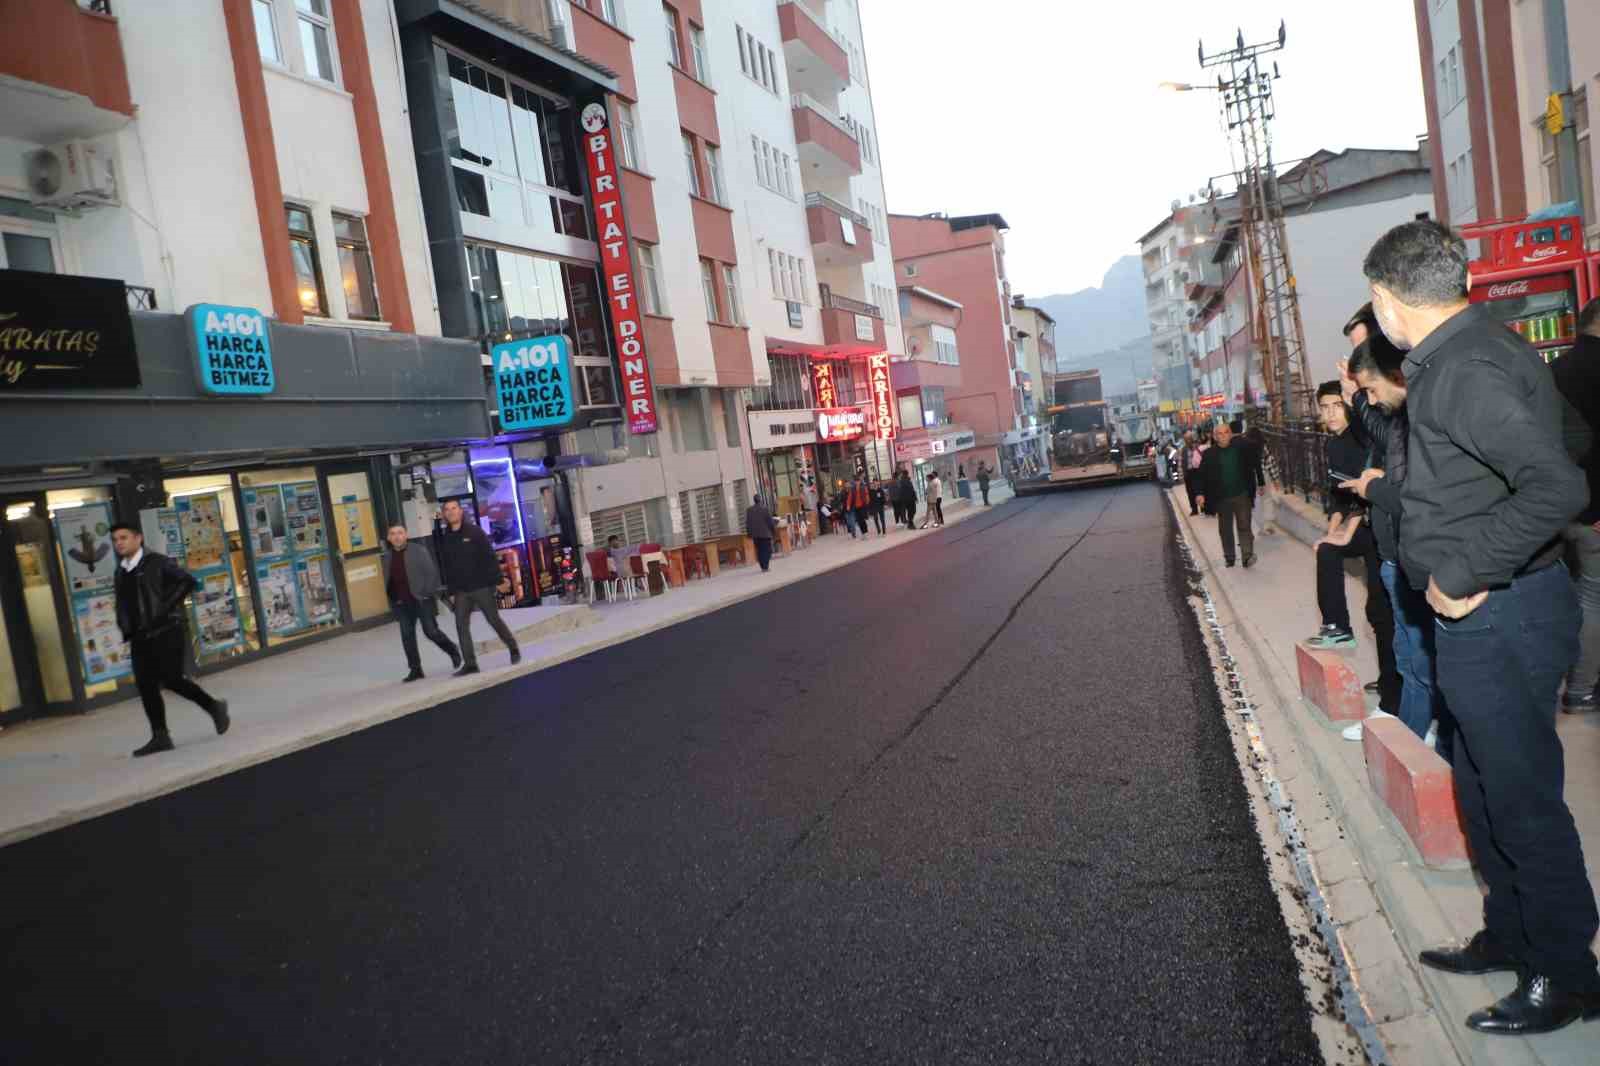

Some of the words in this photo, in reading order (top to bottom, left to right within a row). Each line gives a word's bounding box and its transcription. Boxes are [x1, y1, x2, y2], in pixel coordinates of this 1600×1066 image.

[600, 201, 623, 259] TAT
[612, 273, 632, 310] ET
[206, 334, 265, 354] HARCA
[208, 353, 268, 370] HARCA
[620, 320, 650, 415] DÖNER
[499, 366, 562, 390] HARCA
[502, 384, 564, 407] HARCA
